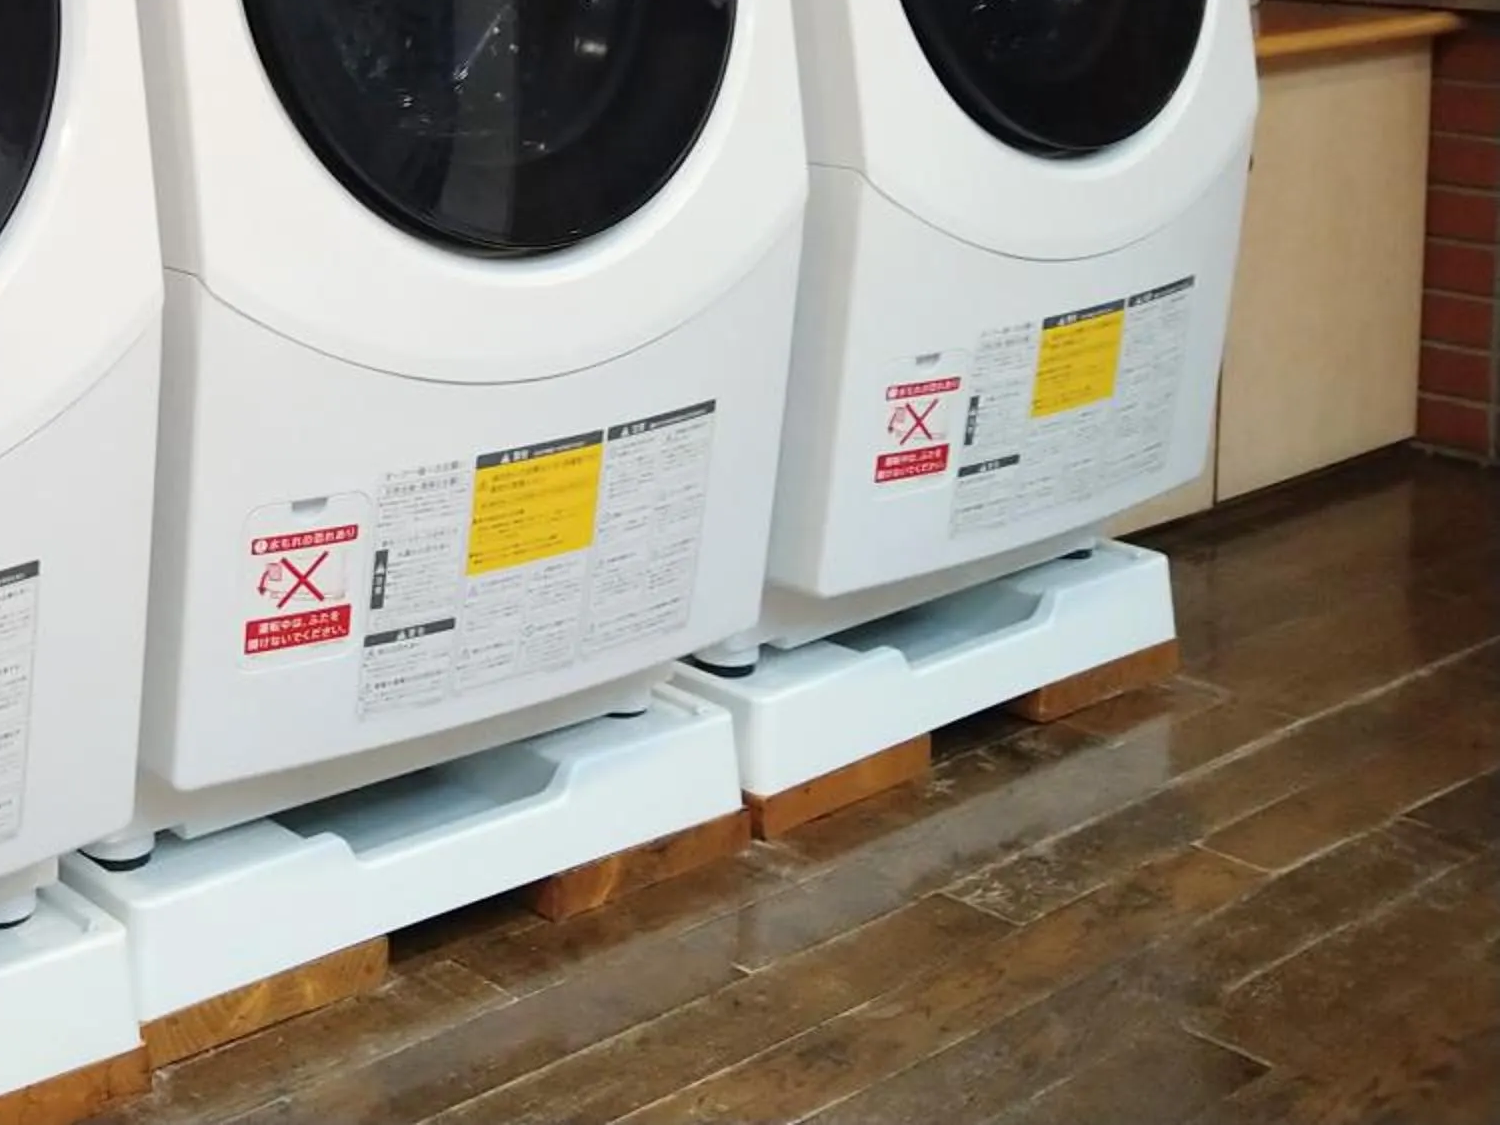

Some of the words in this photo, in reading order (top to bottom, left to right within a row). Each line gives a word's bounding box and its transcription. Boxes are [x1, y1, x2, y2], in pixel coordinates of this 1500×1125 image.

[268, 527, 355, 550] 水もれの恐れあり
